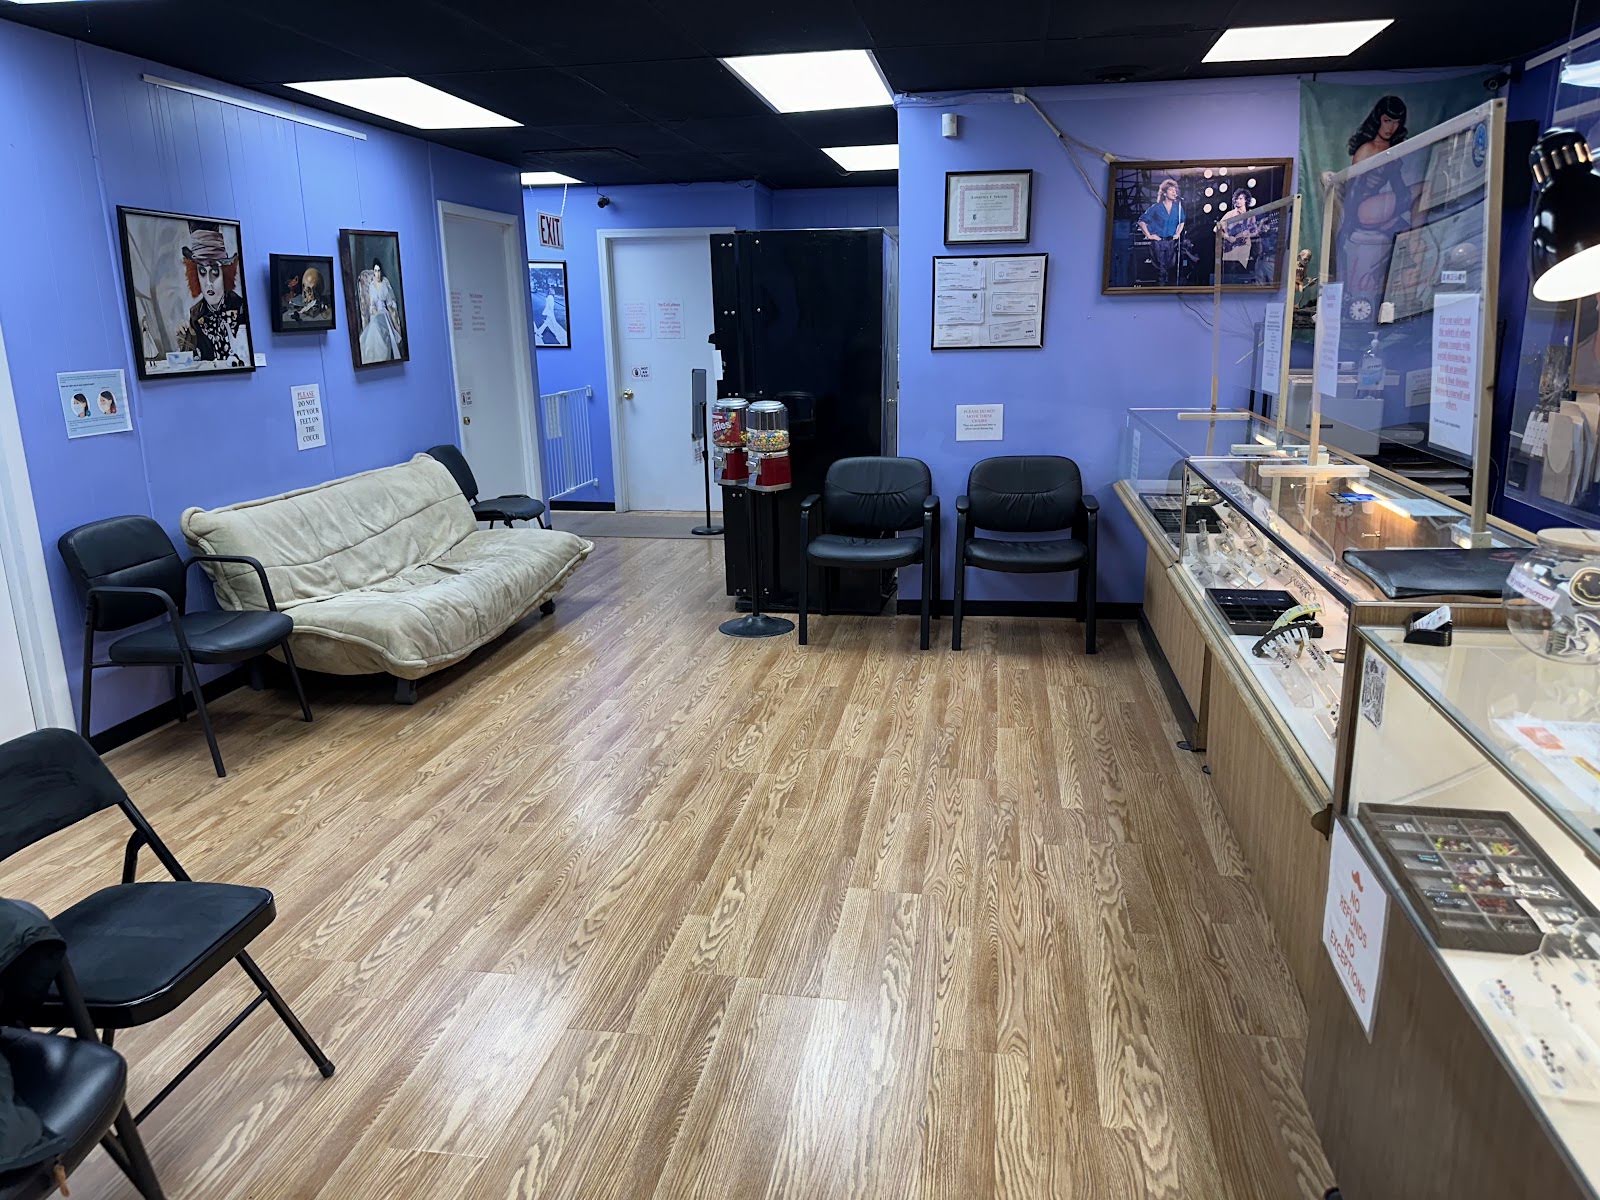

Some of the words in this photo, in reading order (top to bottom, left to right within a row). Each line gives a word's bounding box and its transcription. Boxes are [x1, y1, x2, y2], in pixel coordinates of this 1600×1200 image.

[540, 215, 560, 246] EXIT
[298, 391, 314, 399] PLEASE
[303, 434, 320, 442] COUCH
[1350, 890, 1360, 914] NO
[1340, 894, 1367, 948] REFUNDS
[1344, 934, 1355, 958] NO
[1330, 929, 1366, 1004] EXCEPTIONS
